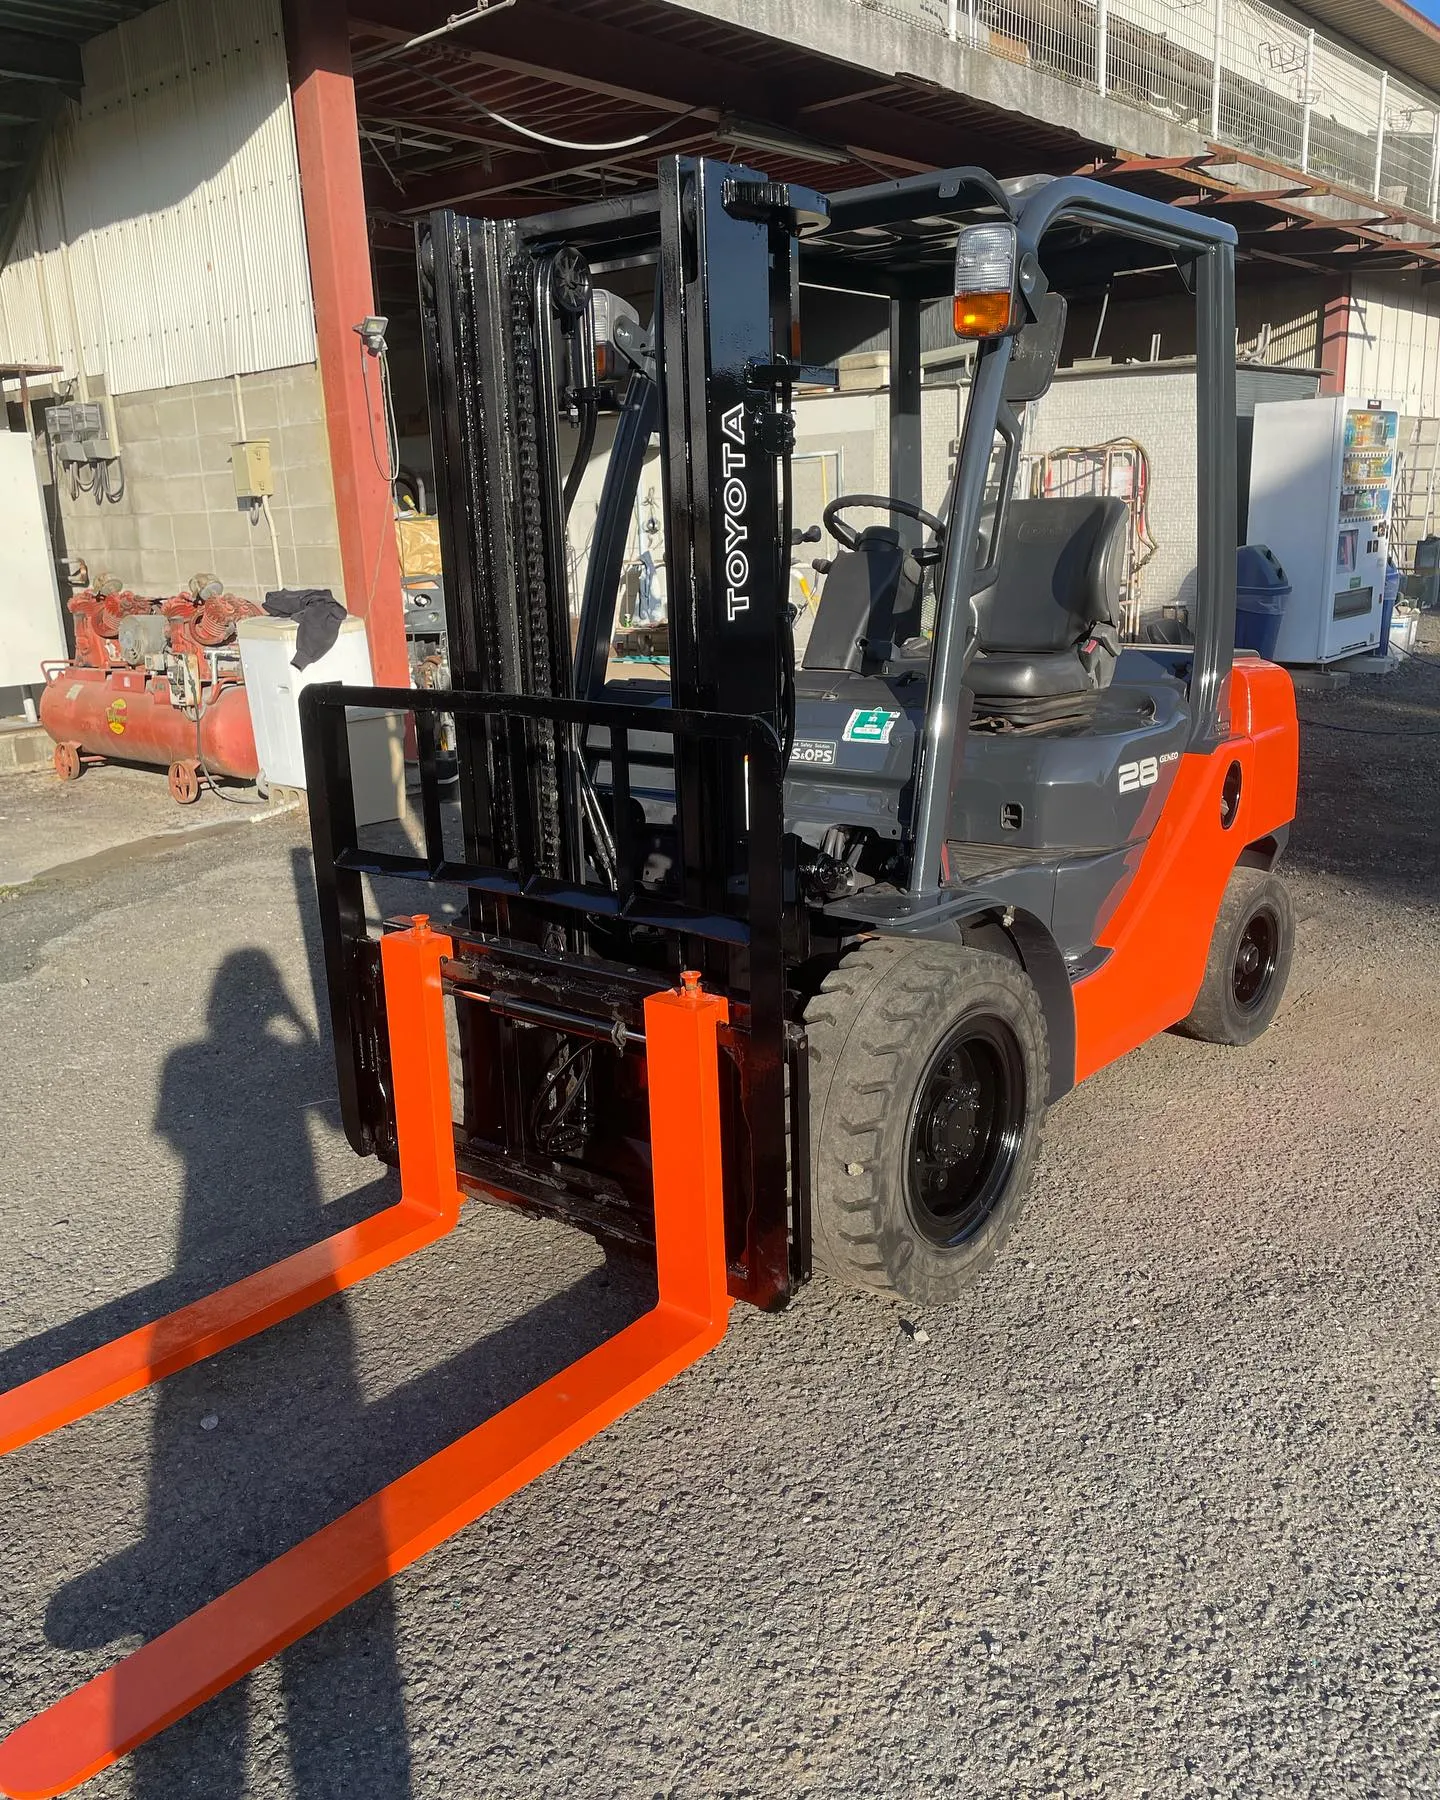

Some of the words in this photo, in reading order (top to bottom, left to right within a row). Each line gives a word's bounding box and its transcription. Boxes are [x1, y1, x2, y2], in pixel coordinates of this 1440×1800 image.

[721, 402, 750, 621] TOYOTA
[789, 747, 833, 762] S&OPS
[1159, 751, 1179, 763] GENEO
[1118, 756, 1158, 793] 28
